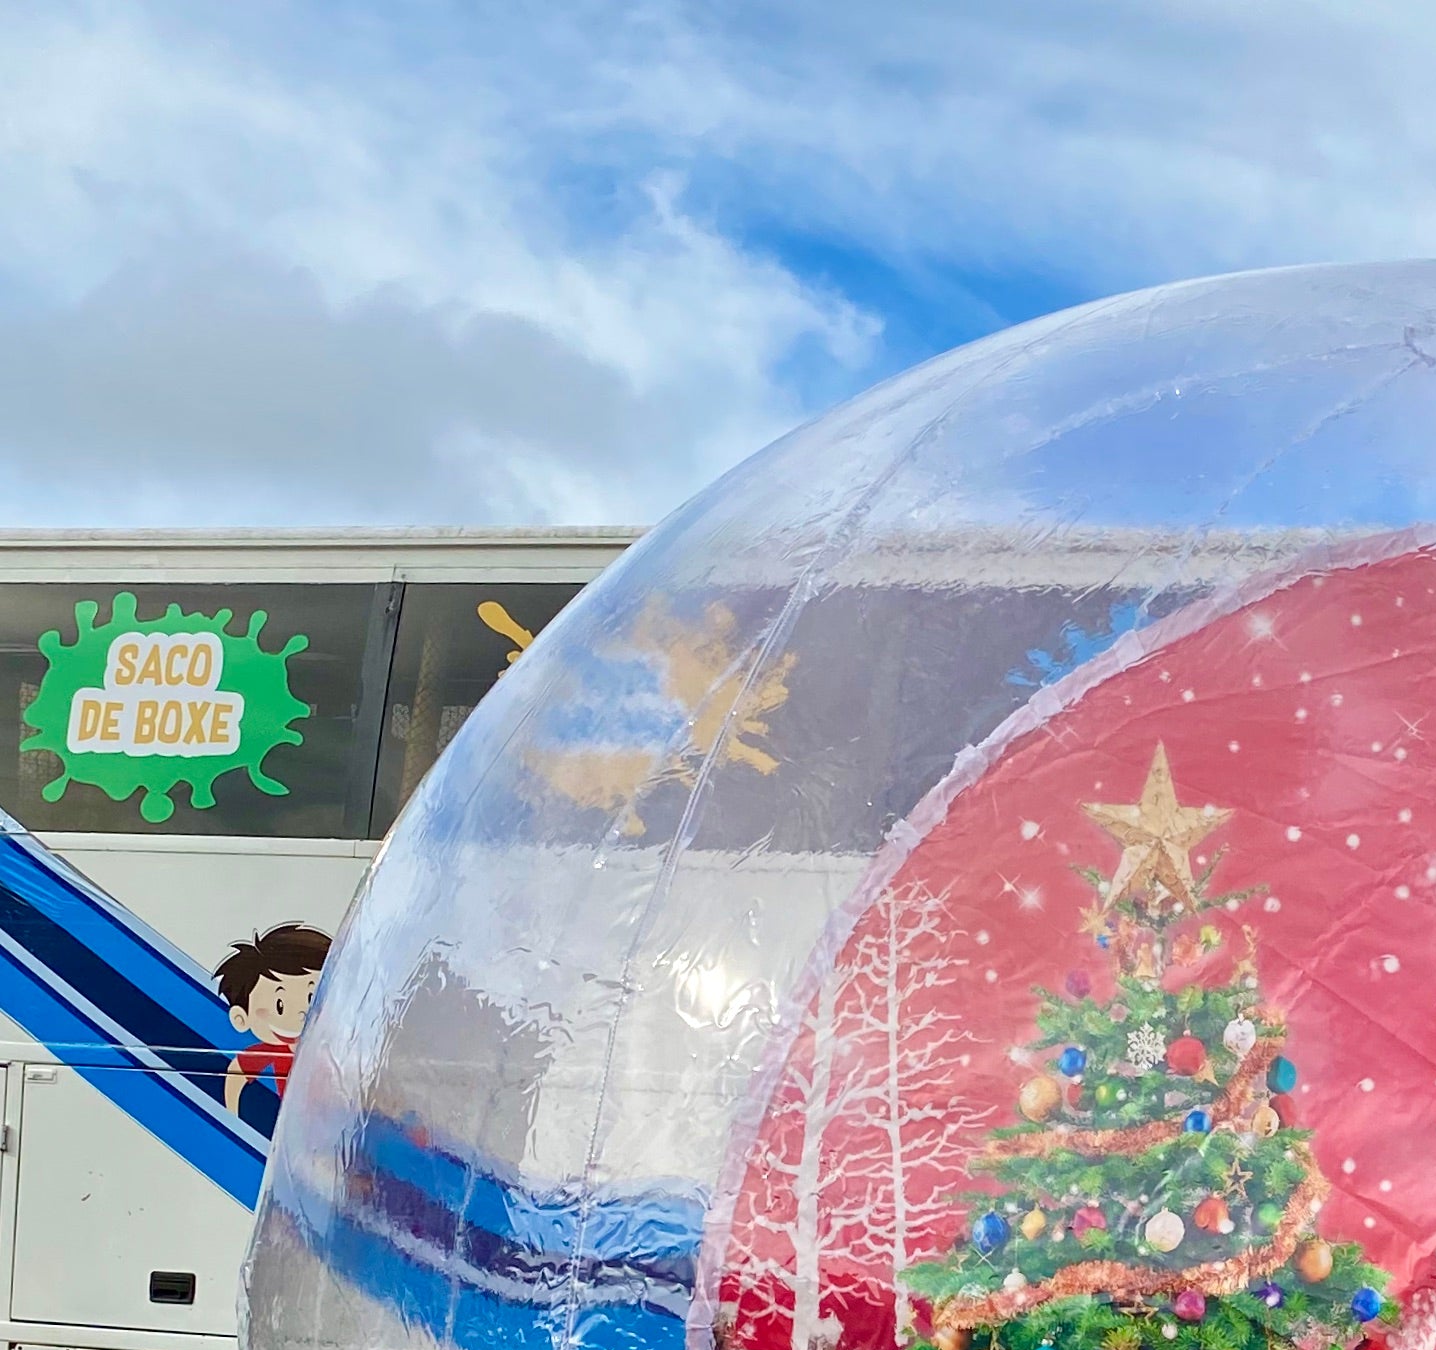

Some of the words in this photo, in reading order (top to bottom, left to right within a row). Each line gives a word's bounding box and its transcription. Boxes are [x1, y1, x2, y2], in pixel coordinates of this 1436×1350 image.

[115, 643, 213, 687] SACO
[78, 699, 124, 742] DE
[134, 699, 233, 744] BOXE
